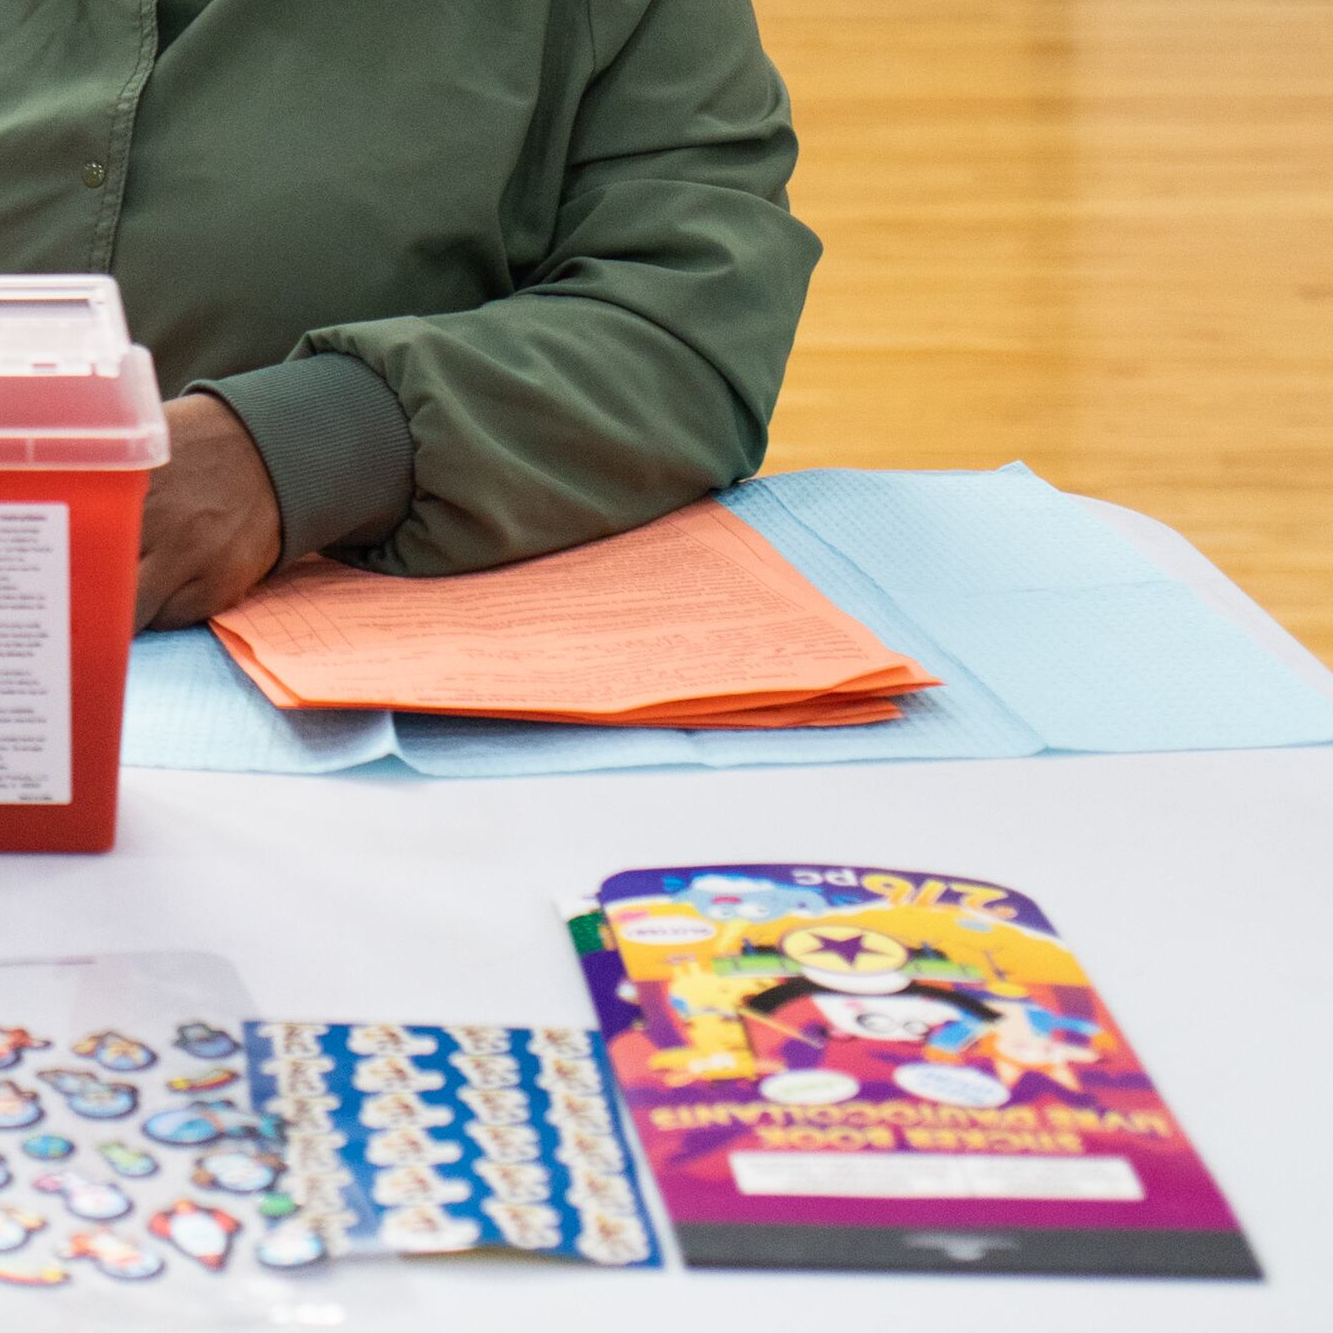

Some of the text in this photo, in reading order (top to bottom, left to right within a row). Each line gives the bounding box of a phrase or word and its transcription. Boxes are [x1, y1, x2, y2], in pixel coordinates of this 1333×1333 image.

[790, 868, 859, 887] pc
[754, 1124, 1086, 1154] STICKER BOOK
